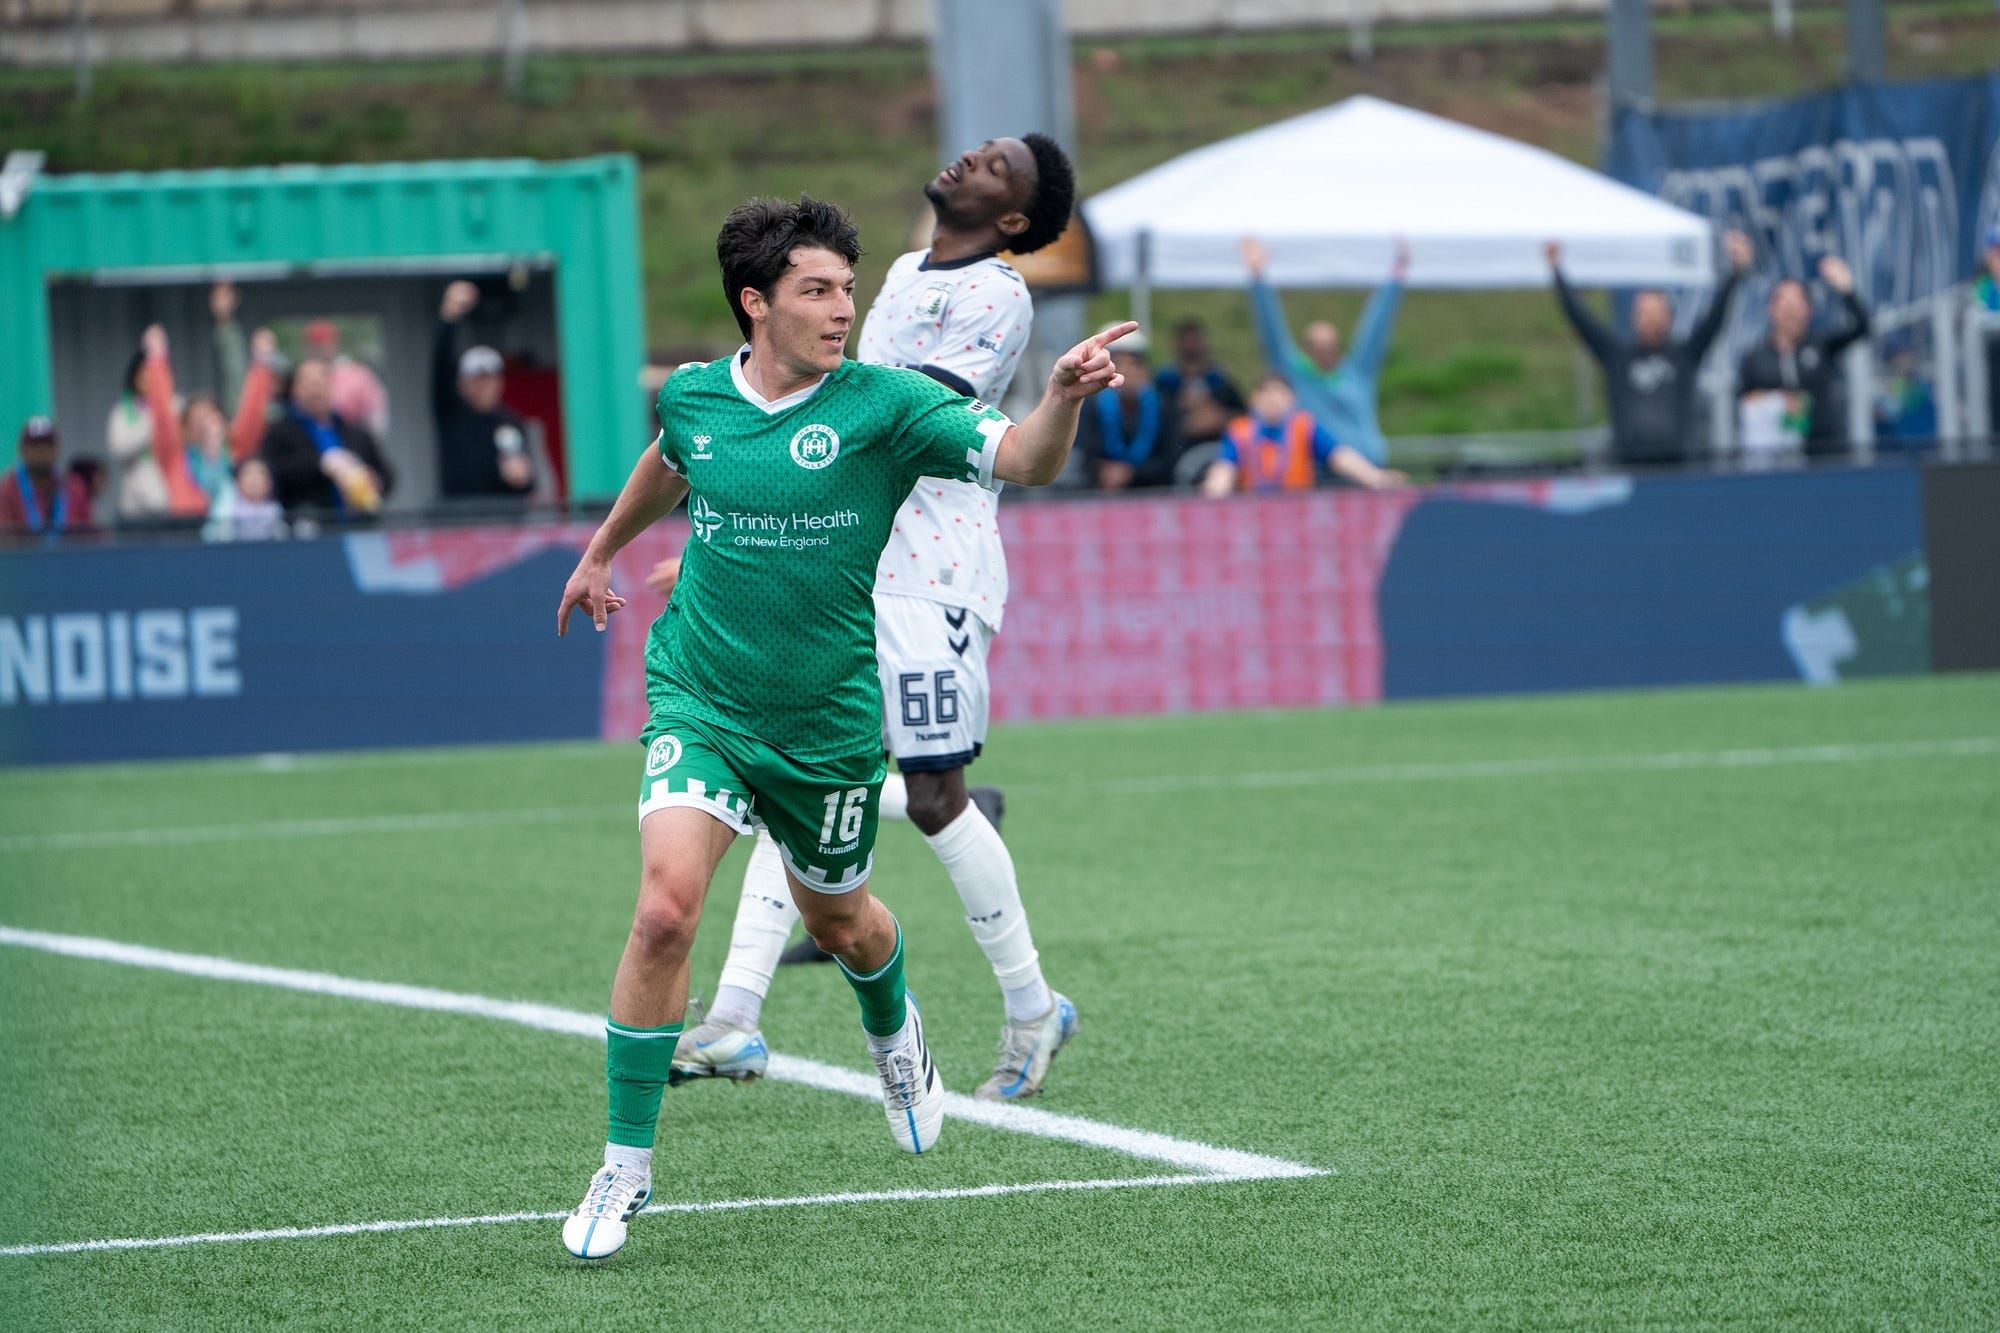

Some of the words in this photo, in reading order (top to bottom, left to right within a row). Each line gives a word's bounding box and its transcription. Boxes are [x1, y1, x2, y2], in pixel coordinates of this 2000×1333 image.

[727, 512, 788, 535] Trinity
[792, 509, 860, 530] Health
[734, 535, 750, 547] Of
[751, 536, 778, 547] New
[779, 535, 830, 550] England
[0, 607, 241, 703] NOISE
[899, 669, 960, 727] 66
[819, 786, 868, 844] 16
[818, 837, 859, 854] hummel
